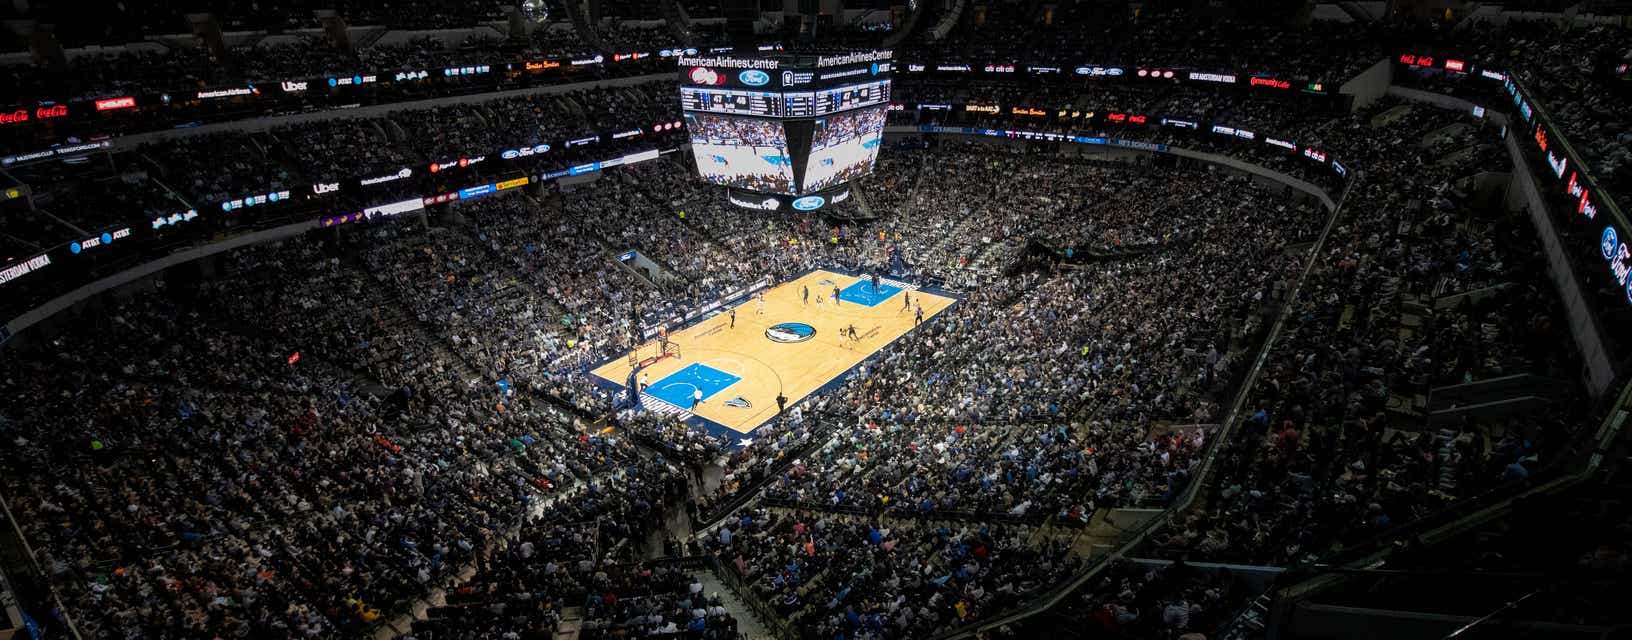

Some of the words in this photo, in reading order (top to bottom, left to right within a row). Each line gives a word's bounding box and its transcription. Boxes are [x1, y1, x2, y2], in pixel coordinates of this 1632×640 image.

[908, 64, 925, 72] Uber
[282, 81, 307, 92] Uber
[37, 105, 67, 119] Coca-Cola
[313, 182, 339, 194] Uber
[82, 237, 100, 250] AT&T
[113, 228, 130, 240] AT&T
